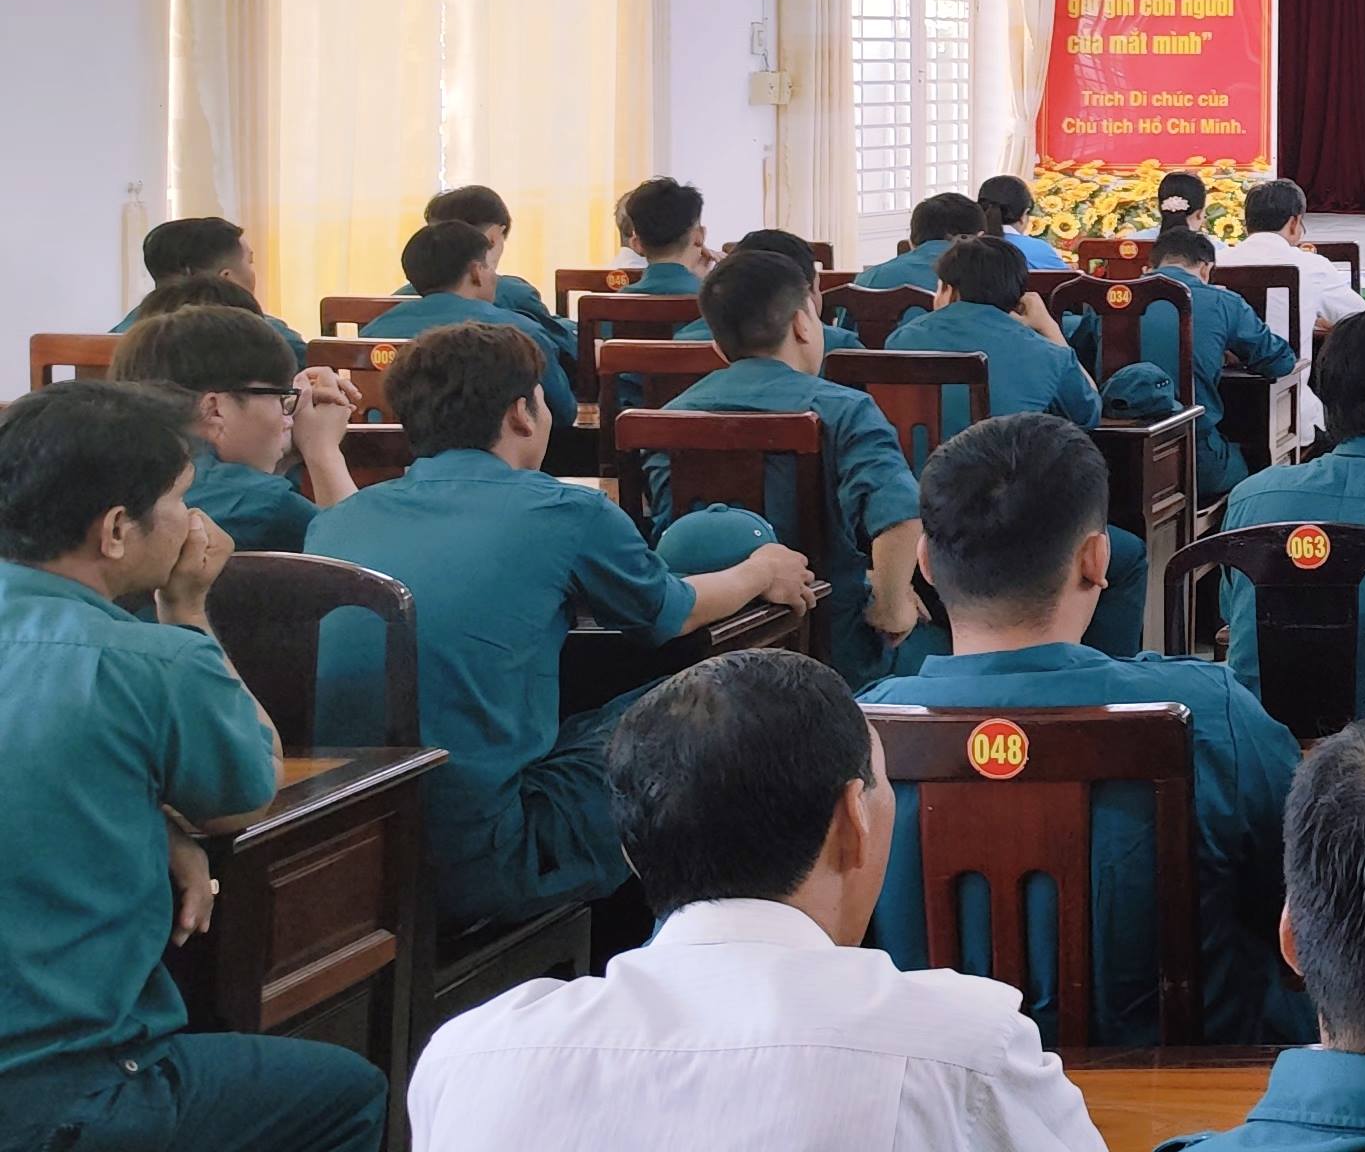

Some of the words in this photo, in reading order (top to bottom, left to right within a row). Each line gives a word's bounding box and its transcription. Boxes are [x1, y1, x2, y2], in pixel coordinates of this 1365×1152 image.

[1110, 290, 1129, 303] 034
[1291, 535, 1326, 559] 063
[971, 733, 1022, 765] 048
